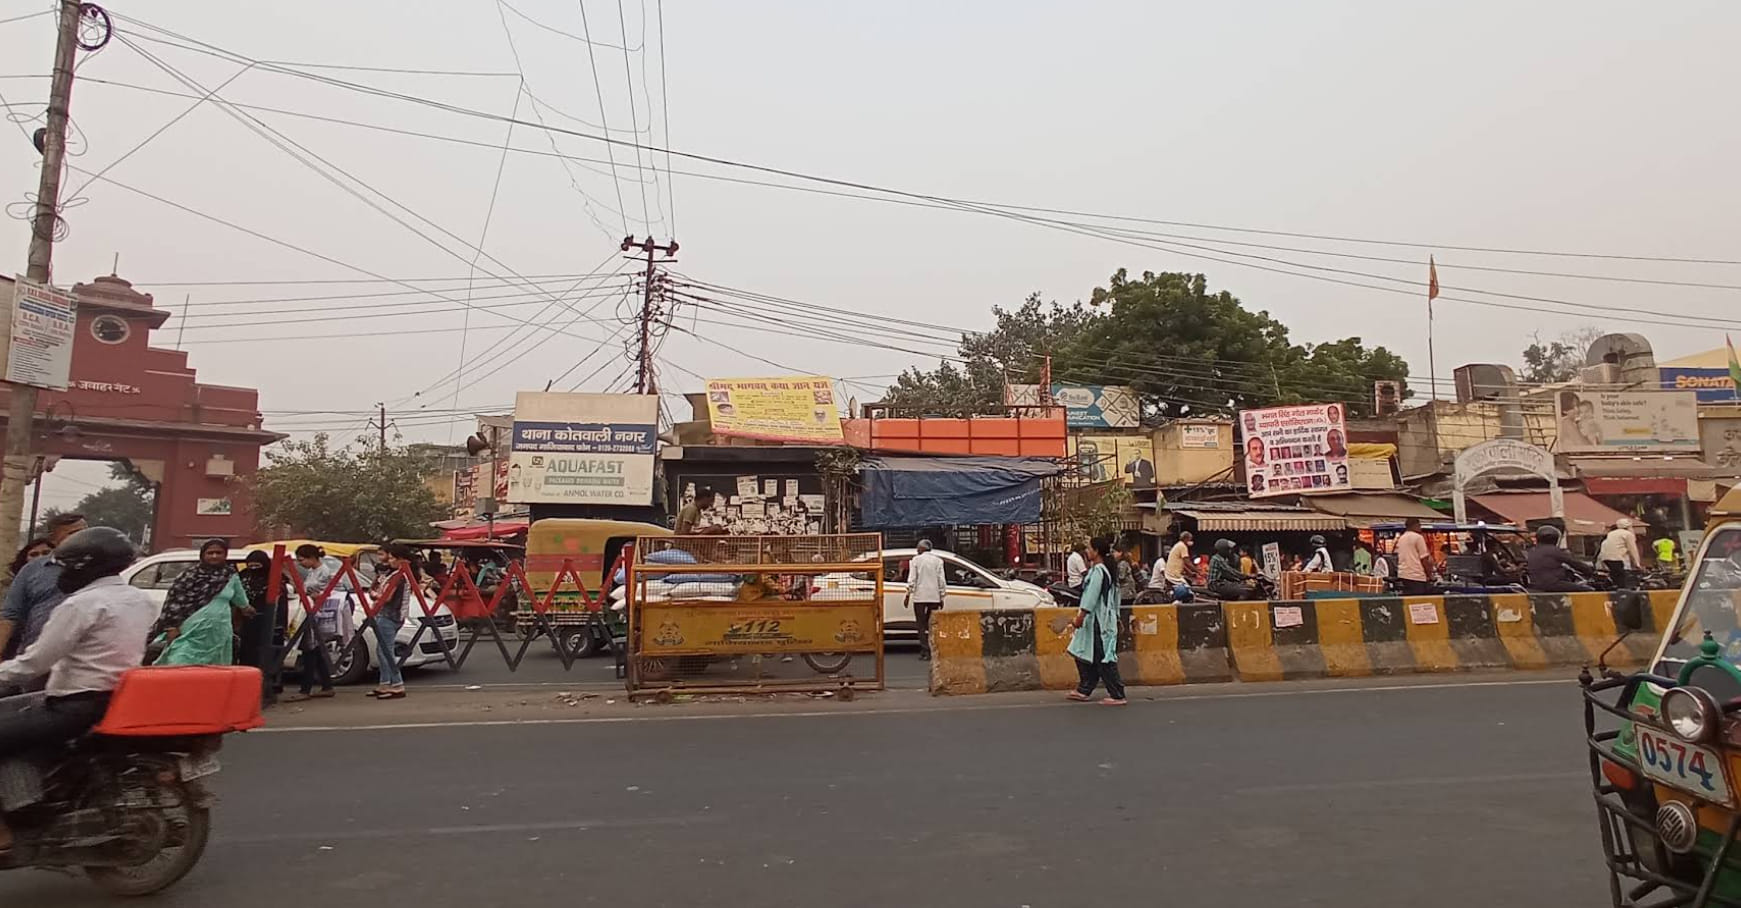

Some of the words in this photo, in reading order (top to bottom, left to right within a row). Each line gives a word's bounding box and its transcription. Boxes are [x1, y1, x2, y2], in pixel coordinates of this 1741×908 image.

[78, 380, 112, 392] जवाहर
[1675, 375, 1735, 388] SONATA
[521, 429, 552, 440] थाना
[554, 427, 611, 442] कोतवाली
[614, 431, 647, 443] नगर
[546, 458, 624, 474] AQUAFAST
[744, 620, 781, 633] 112
[1642, 732, 1716, 791] 0574
